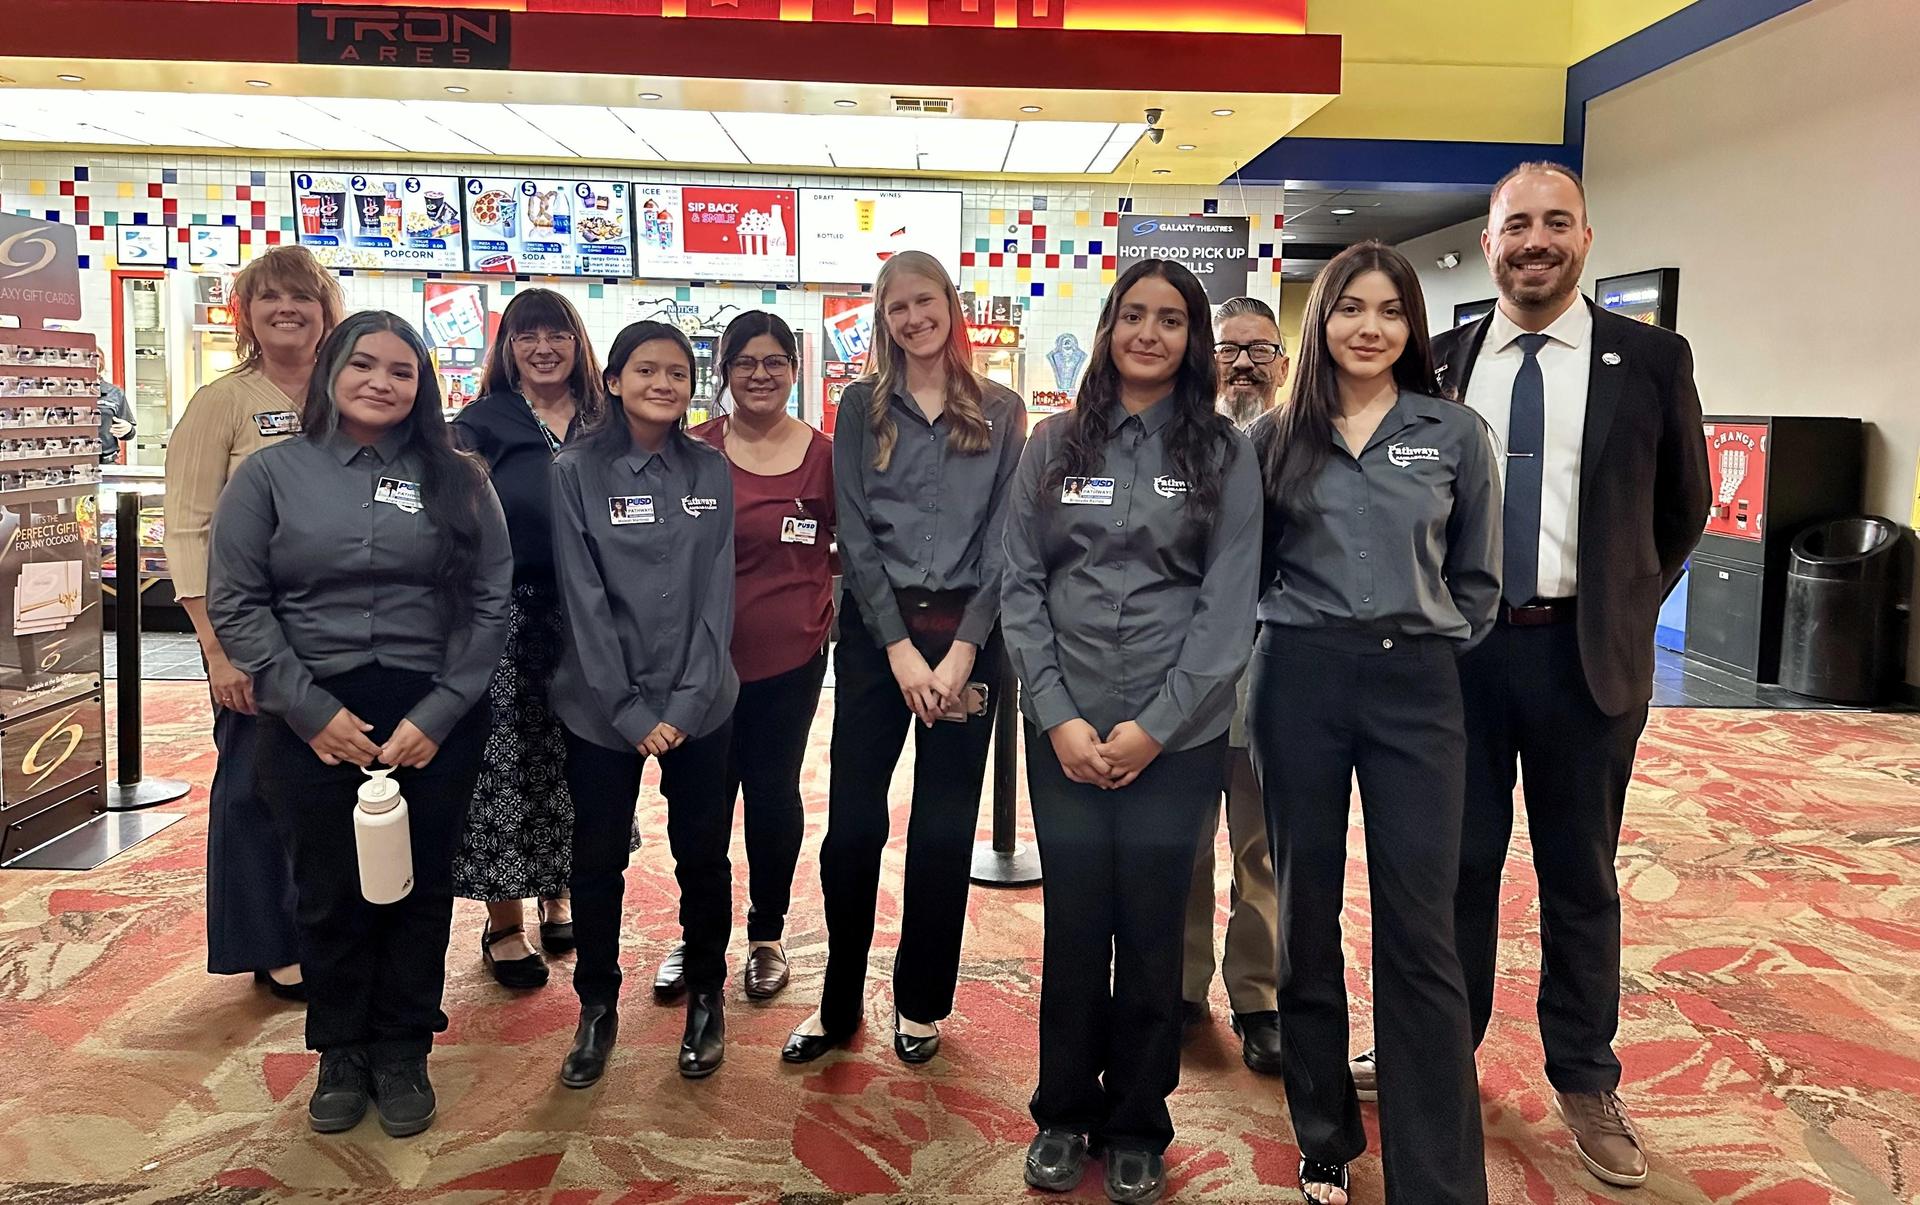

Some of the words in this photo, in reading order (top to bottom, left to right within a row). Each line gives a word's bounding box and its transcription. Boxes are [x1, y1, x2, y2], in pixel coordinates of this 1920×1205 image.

[311, 9, 496, 44] TRON
[341, 45, 470, 63] ARES
[300, 175, 308, 189] 1
[354, 178, 365, 191] 2
[408, 178, 418, 191] 3
[469, 180, 480, 194] 4
[524, 182, 534, 195] 5
[578, 183, 590, 197] 6
[687, 202, 705, 212] SIP
[708, 203, 739, 213] BACK
[702, 213, 736, 223] SMILE
[1159, 223, 1195, 232] GALAXY
[384, 250, 434, 258] POPCORN
[522, 253, 546, 261] SODA
[1120, 246, 1147, 258] HOT
[1150, 246, 1189, 259] FOOD
[1192, 247, 1223, 259] PICK
[1227, 248, 1245, 259] UP
[0, 287, 21, 300] AXY
[23, 289, 43, 302] GIFT
[45, 291, 76, 305] CARDS
[668, 305, 698, 313] NOTICE
[1713, 431, 1755, 450] CHANGE
[1387, 444, 1439, 457] Pathways
[626, 497, 652, 506] PUSD
[47, 513, 59, 523] THE
[16, 524, 55, 541] PERFECT
[56, 521, 78, 535] GIFT!
[16, 541, 30, 551] FOR
[30, 539, 45, 549] ANY
[45, 534, 78, 547] OCCASION
